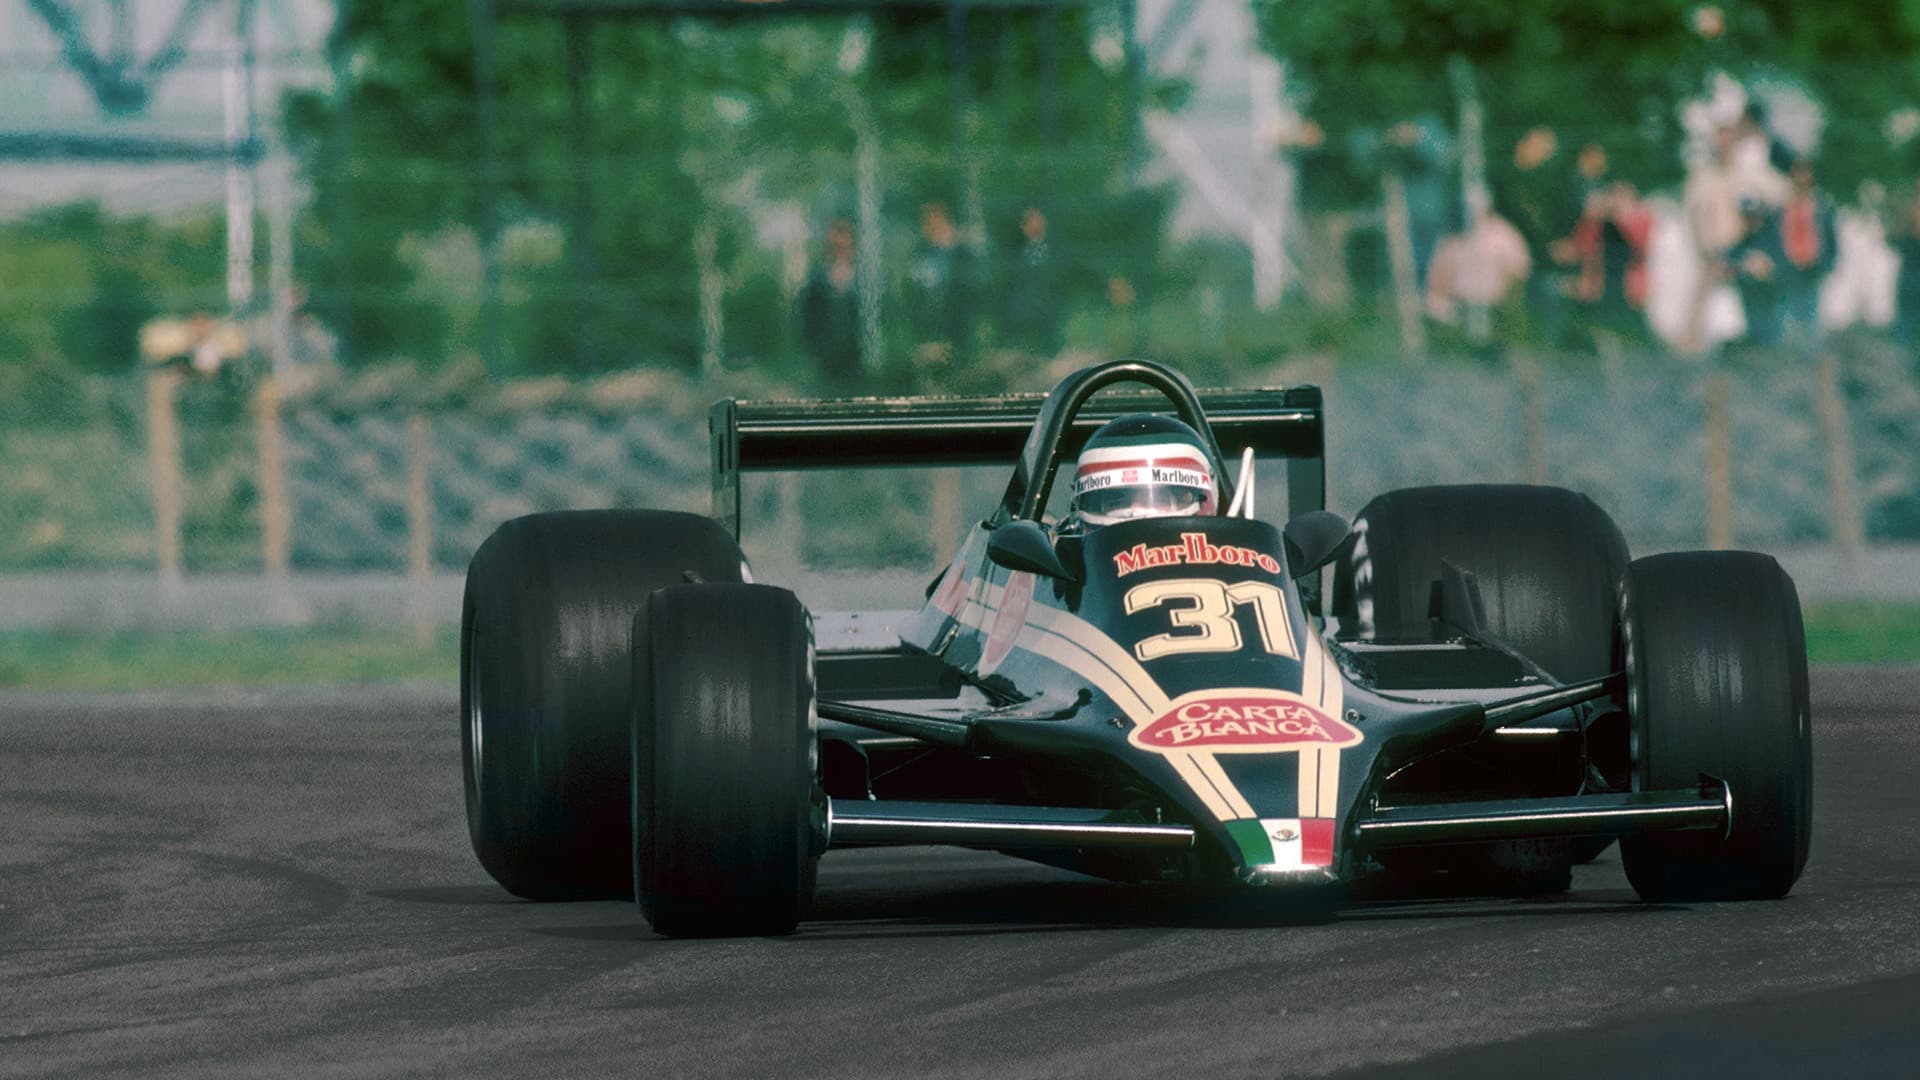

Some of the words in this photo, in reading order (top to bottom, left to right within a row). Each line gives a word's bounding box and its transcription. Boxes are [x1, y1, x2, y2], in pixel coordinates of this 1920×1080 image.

[1151, 468, 1199, 485] Marlboro
[1114, 533, 1280, 577] Marlboro
[1124, 578, 1299, 661] 31
[1177, 703, 1318, 722] CARTA
[1156, 720, 1332, 744] BLANCA
